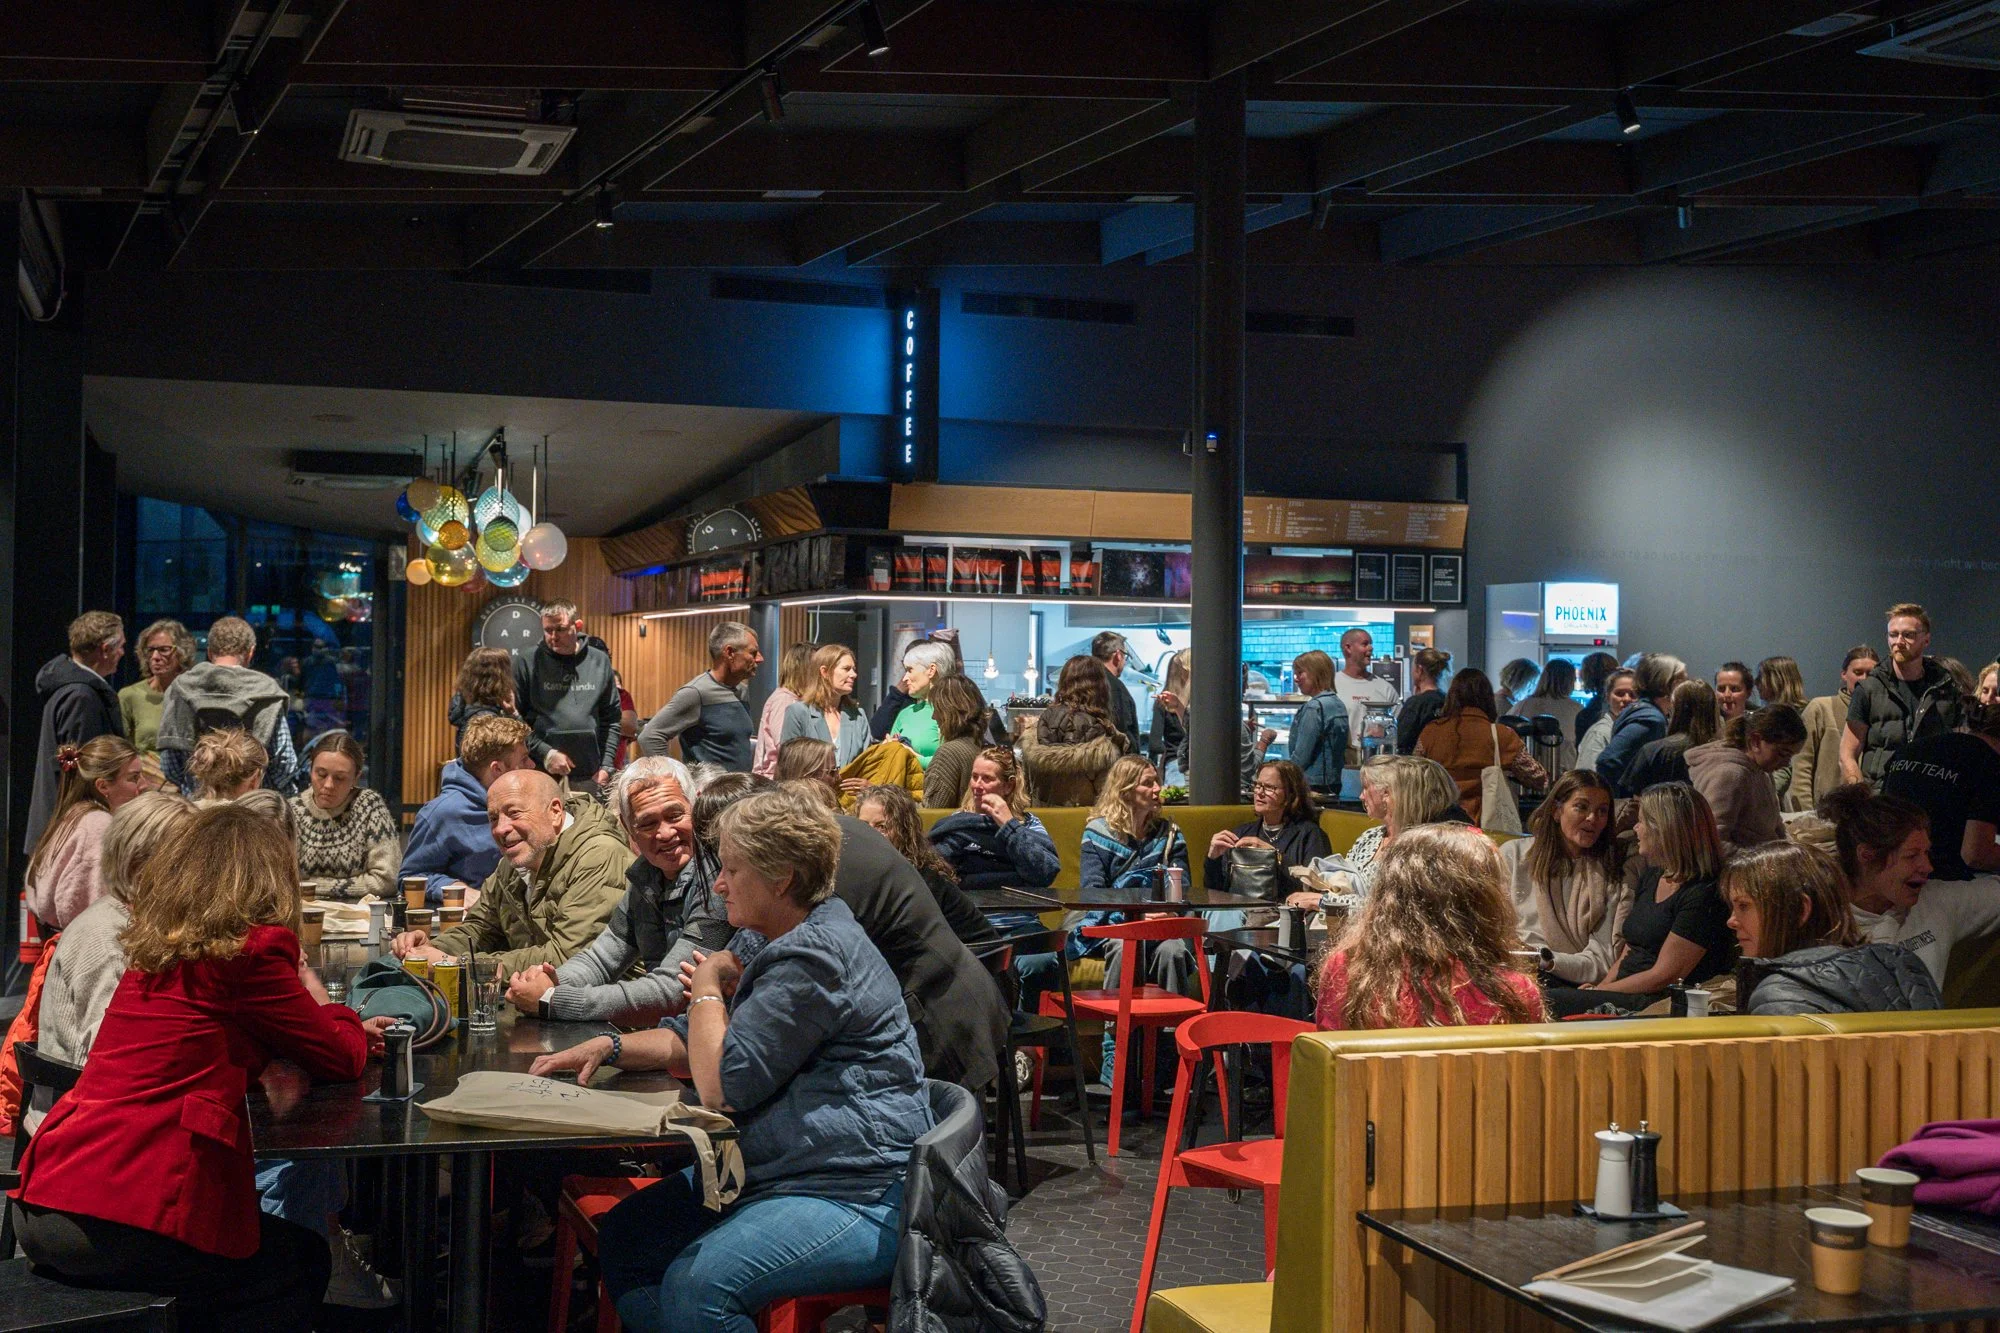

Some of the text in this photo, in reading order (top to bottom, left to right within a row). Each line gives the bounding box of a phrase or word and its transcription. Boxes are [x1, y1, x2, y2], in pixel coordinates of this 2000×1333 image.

[905, 310, 914, 464] COFFEE
[1555, 605, 1607, 621] PHOENIX
[1922, 763, 1959, 784] TEAM
